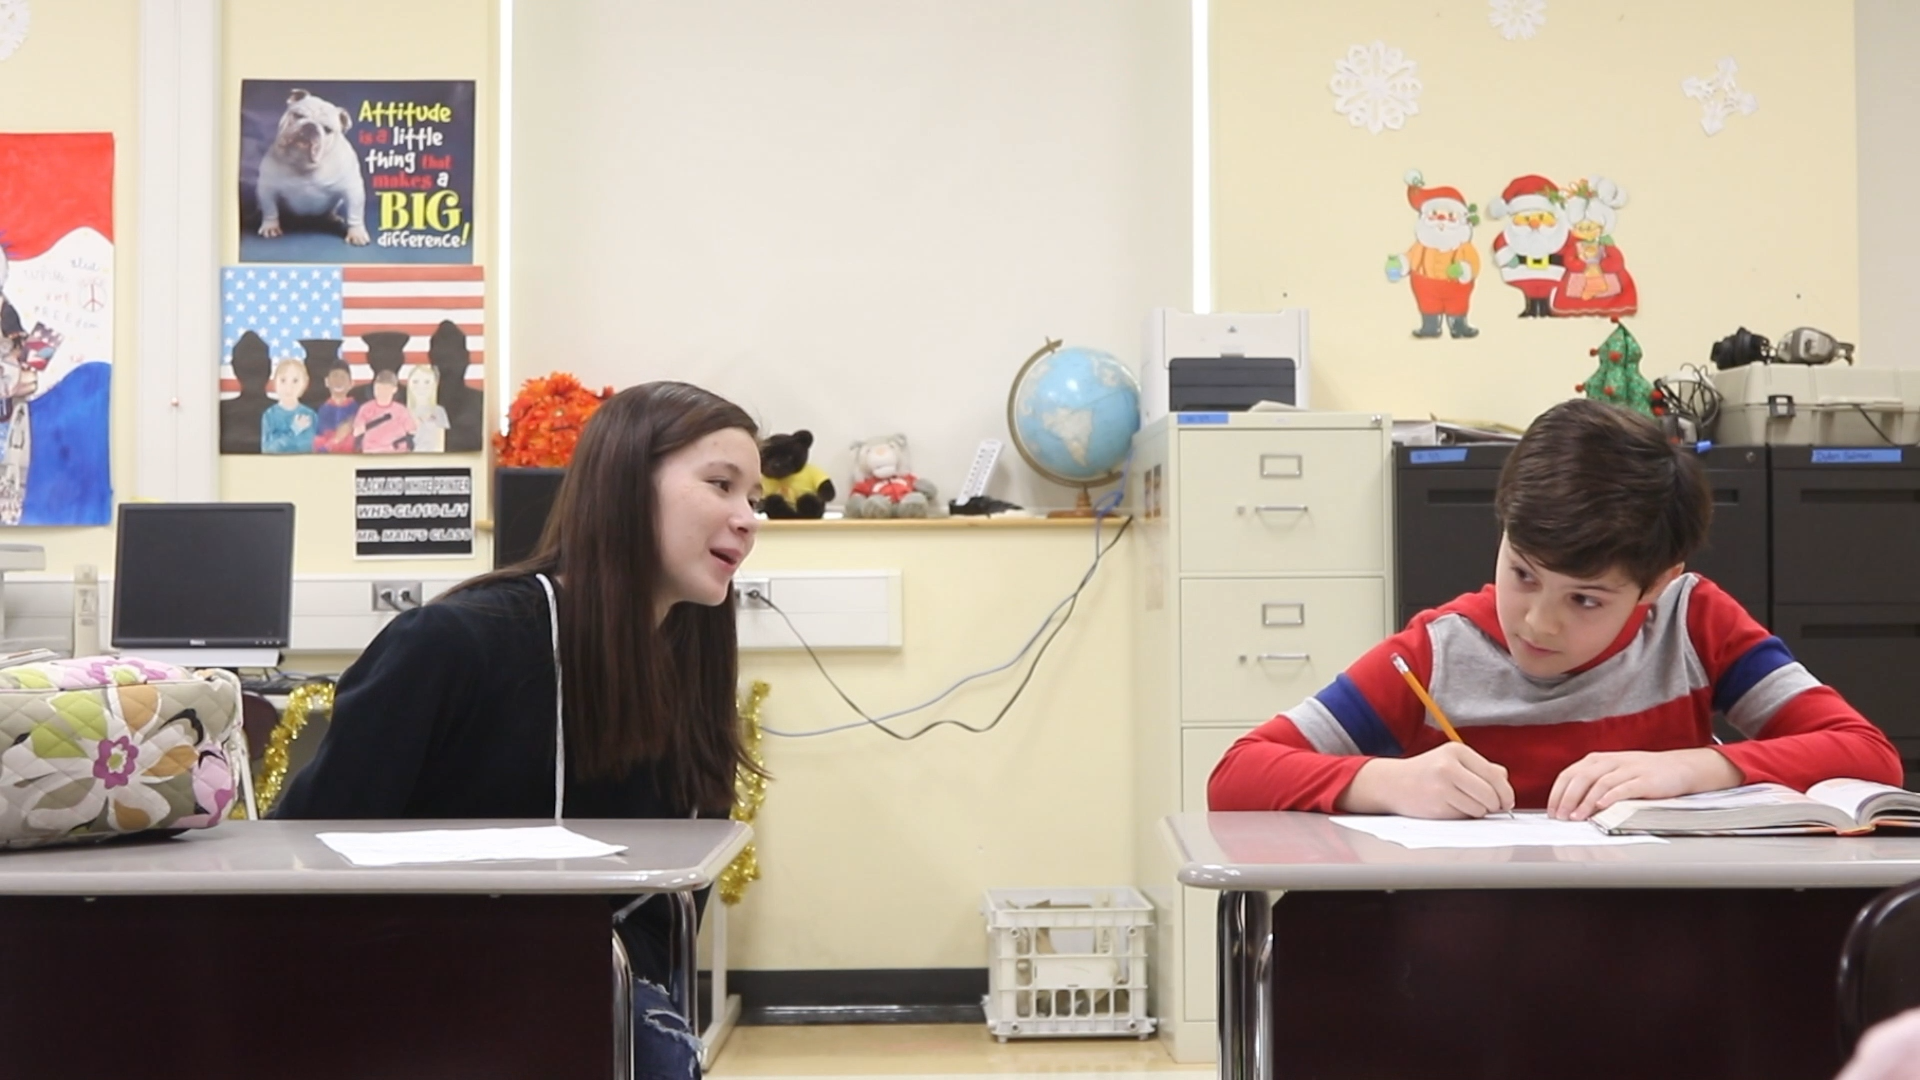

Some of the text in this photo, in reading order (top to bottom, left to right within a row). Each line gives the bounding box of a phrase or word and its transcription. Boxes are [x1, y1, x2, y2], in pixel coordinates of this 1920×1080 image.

[358, 100, 452, 128] Attitude
[358, 126, 443, 151] is a little
[365, 149, 453, 174] thing that
[372, 171, 449, 189] makes a
[375, 189, 463, 232] BIG
[377, 222, 470, 248] difference!
[405, 476, 433, 495] WHITE
[434, 475, 470, 495] PRINTER
[356, 528, 473, 542] MR. MAIN'S CLASS
